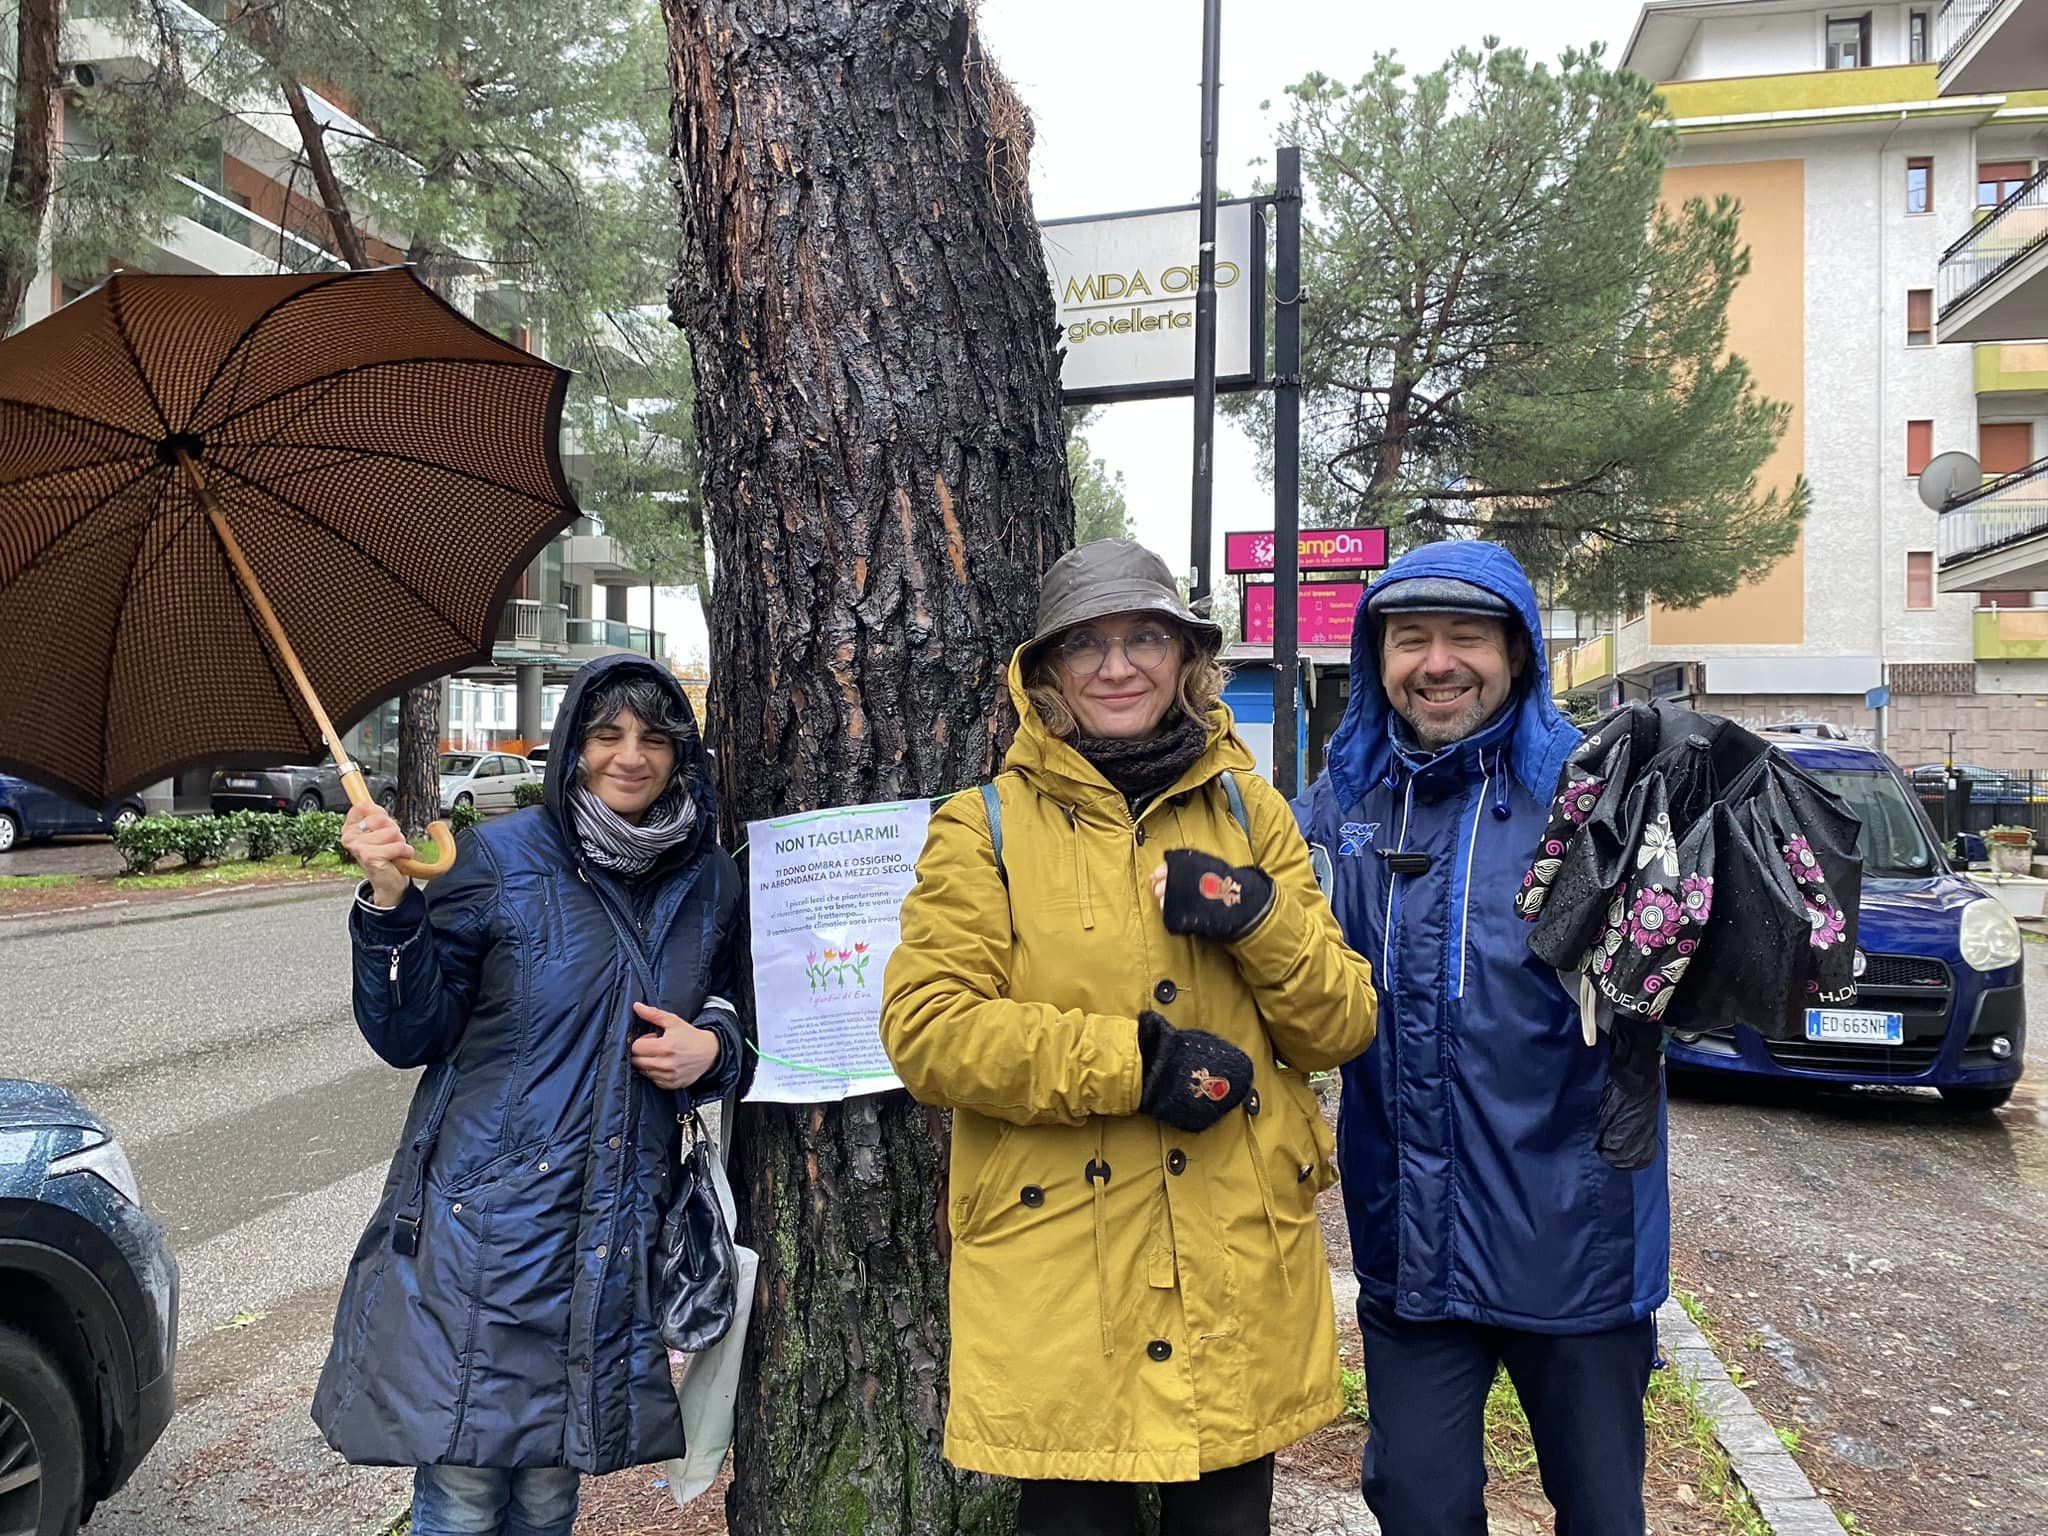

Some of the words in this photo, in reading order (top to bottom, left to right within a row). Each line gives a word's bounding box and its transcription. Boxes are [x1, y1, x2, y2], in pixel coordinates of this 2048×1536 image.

[1063, 268, 1152, 304] MIDA
[1068, 308, 1192, 344] gioielleria
[1298, 534, 1363, 558] ampOn
[775, 836, 804, 854] NON
[808, 824, 899, 848] TAGLIARMI!
[776, 869, 782, 878] TI
[783, 864, 806, 877] DONO
[808, 860, 842, 872] OMBRA
[844, 859, 849, 867] E
[852, 853, 902, 866] OSSIGENO
[760, 882, 769, 891] IN
[771, 872, 827, 889] ABBONDANZA
[829, 870, 842, 879] DA
[845, 866, 880, 878] MEZZO
[826, 893, 840, 902] che
[835, 901, 857, 910] bene,
[871, 898, 892, 906] venti
[805, 913, 816, 921] nel
[1822, 1016, 1839, 1032] ED
[1843, 1017, 1887, 1035] 663NH
